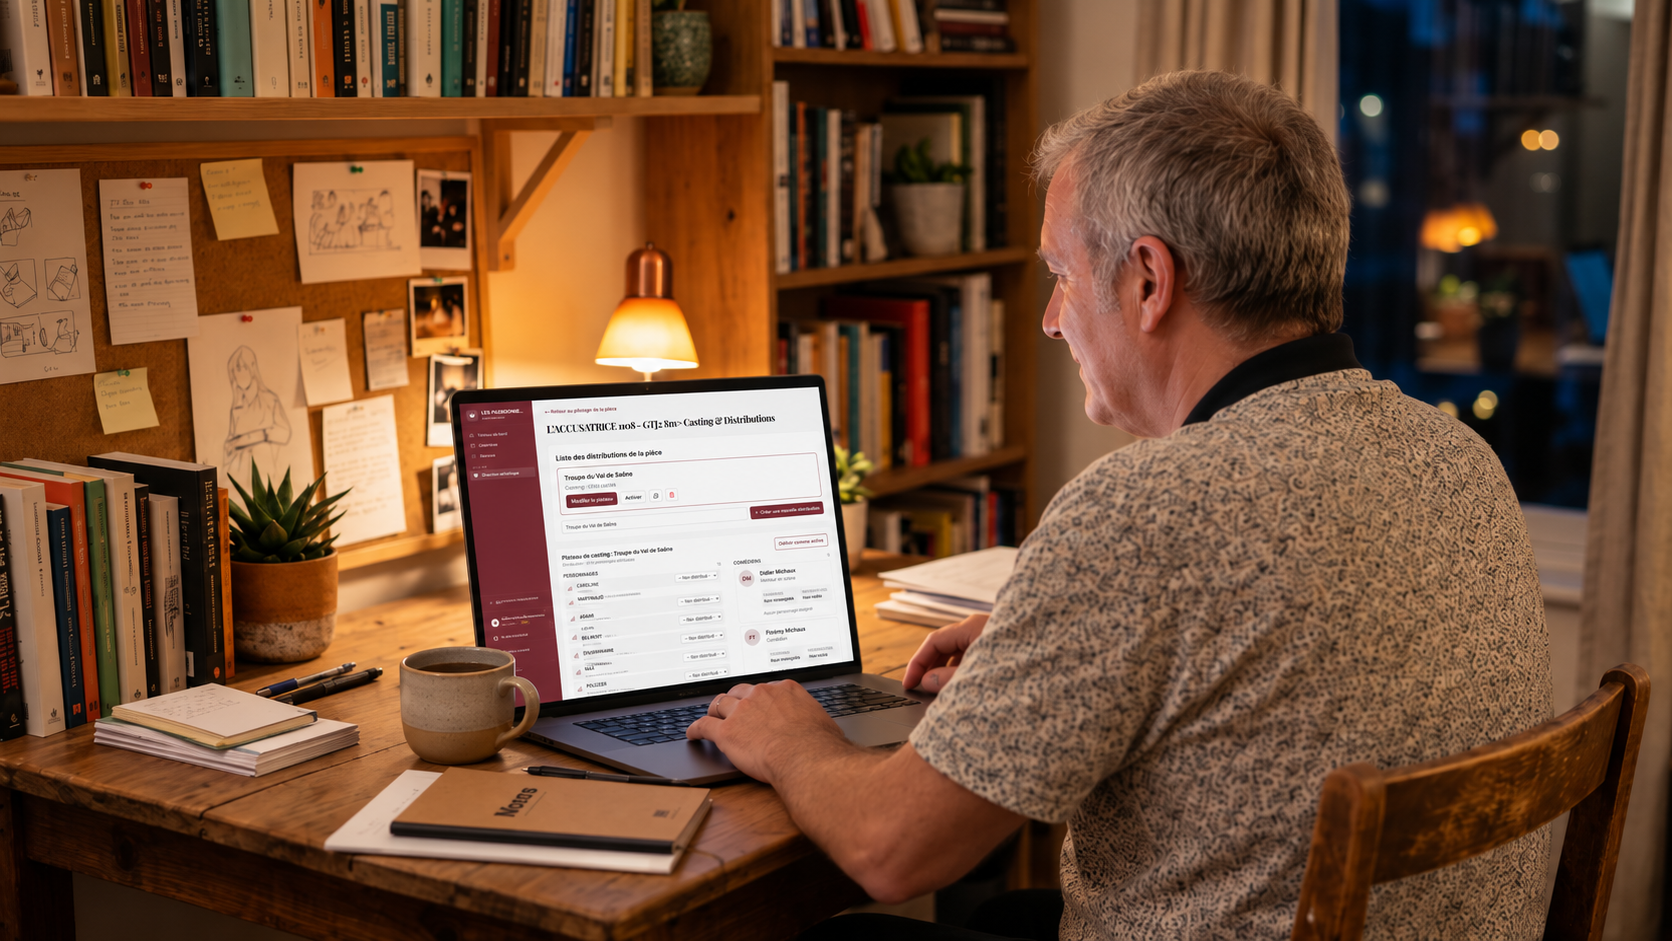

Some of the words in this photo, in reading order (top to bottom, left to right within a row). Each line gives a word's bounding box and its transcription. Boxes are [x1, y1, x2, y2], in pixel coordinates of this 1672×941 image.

[683, 418, 713, 427] Casting
[715, 416, 722, 425] &
[724, 414, 776, 424] Distributions
